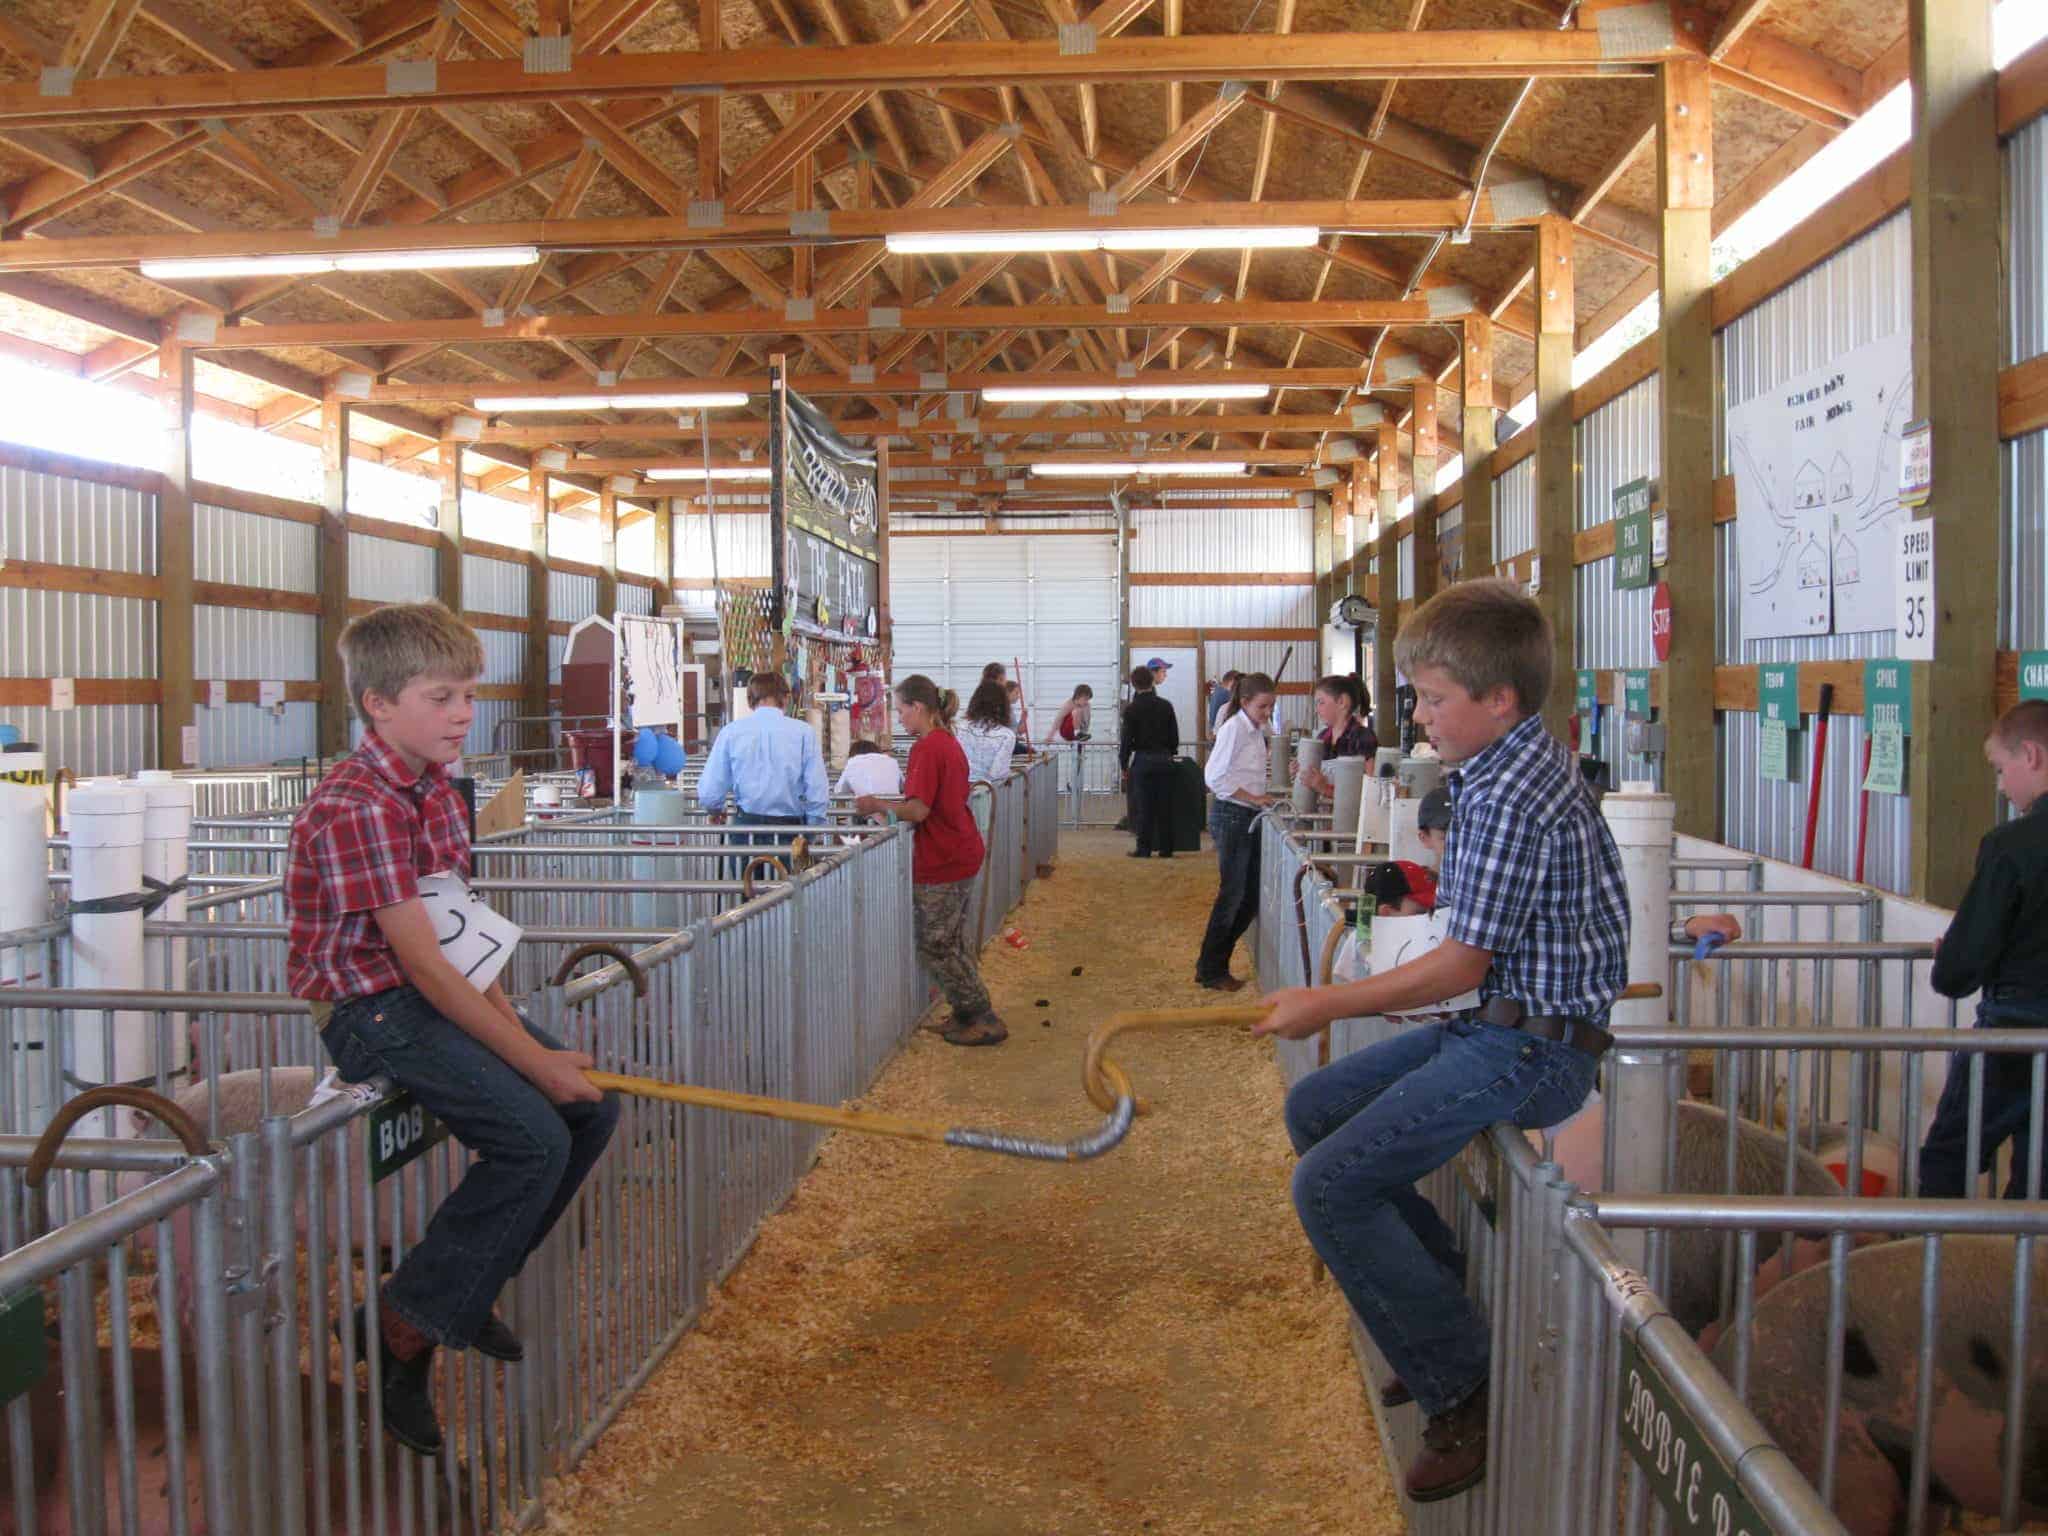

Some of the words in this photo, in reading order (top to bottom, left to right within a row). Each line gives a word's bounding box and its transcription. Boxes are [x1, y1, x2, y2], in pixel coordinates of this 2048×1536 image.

[1903, 531, 1929, 555] SPEED
[1906, 560, 1929, 583] LIMIT
[1653, 607, 1670, 636] STOP
[1904, 596, 1926, 639] 35
[1876, 669, 1897, 689] SPIKE
[1873, 703, 1900, 724] STREET
[379, 1103, 423, 1162] BOB
[1624, 1368, 1703, 1525] ABBIE
